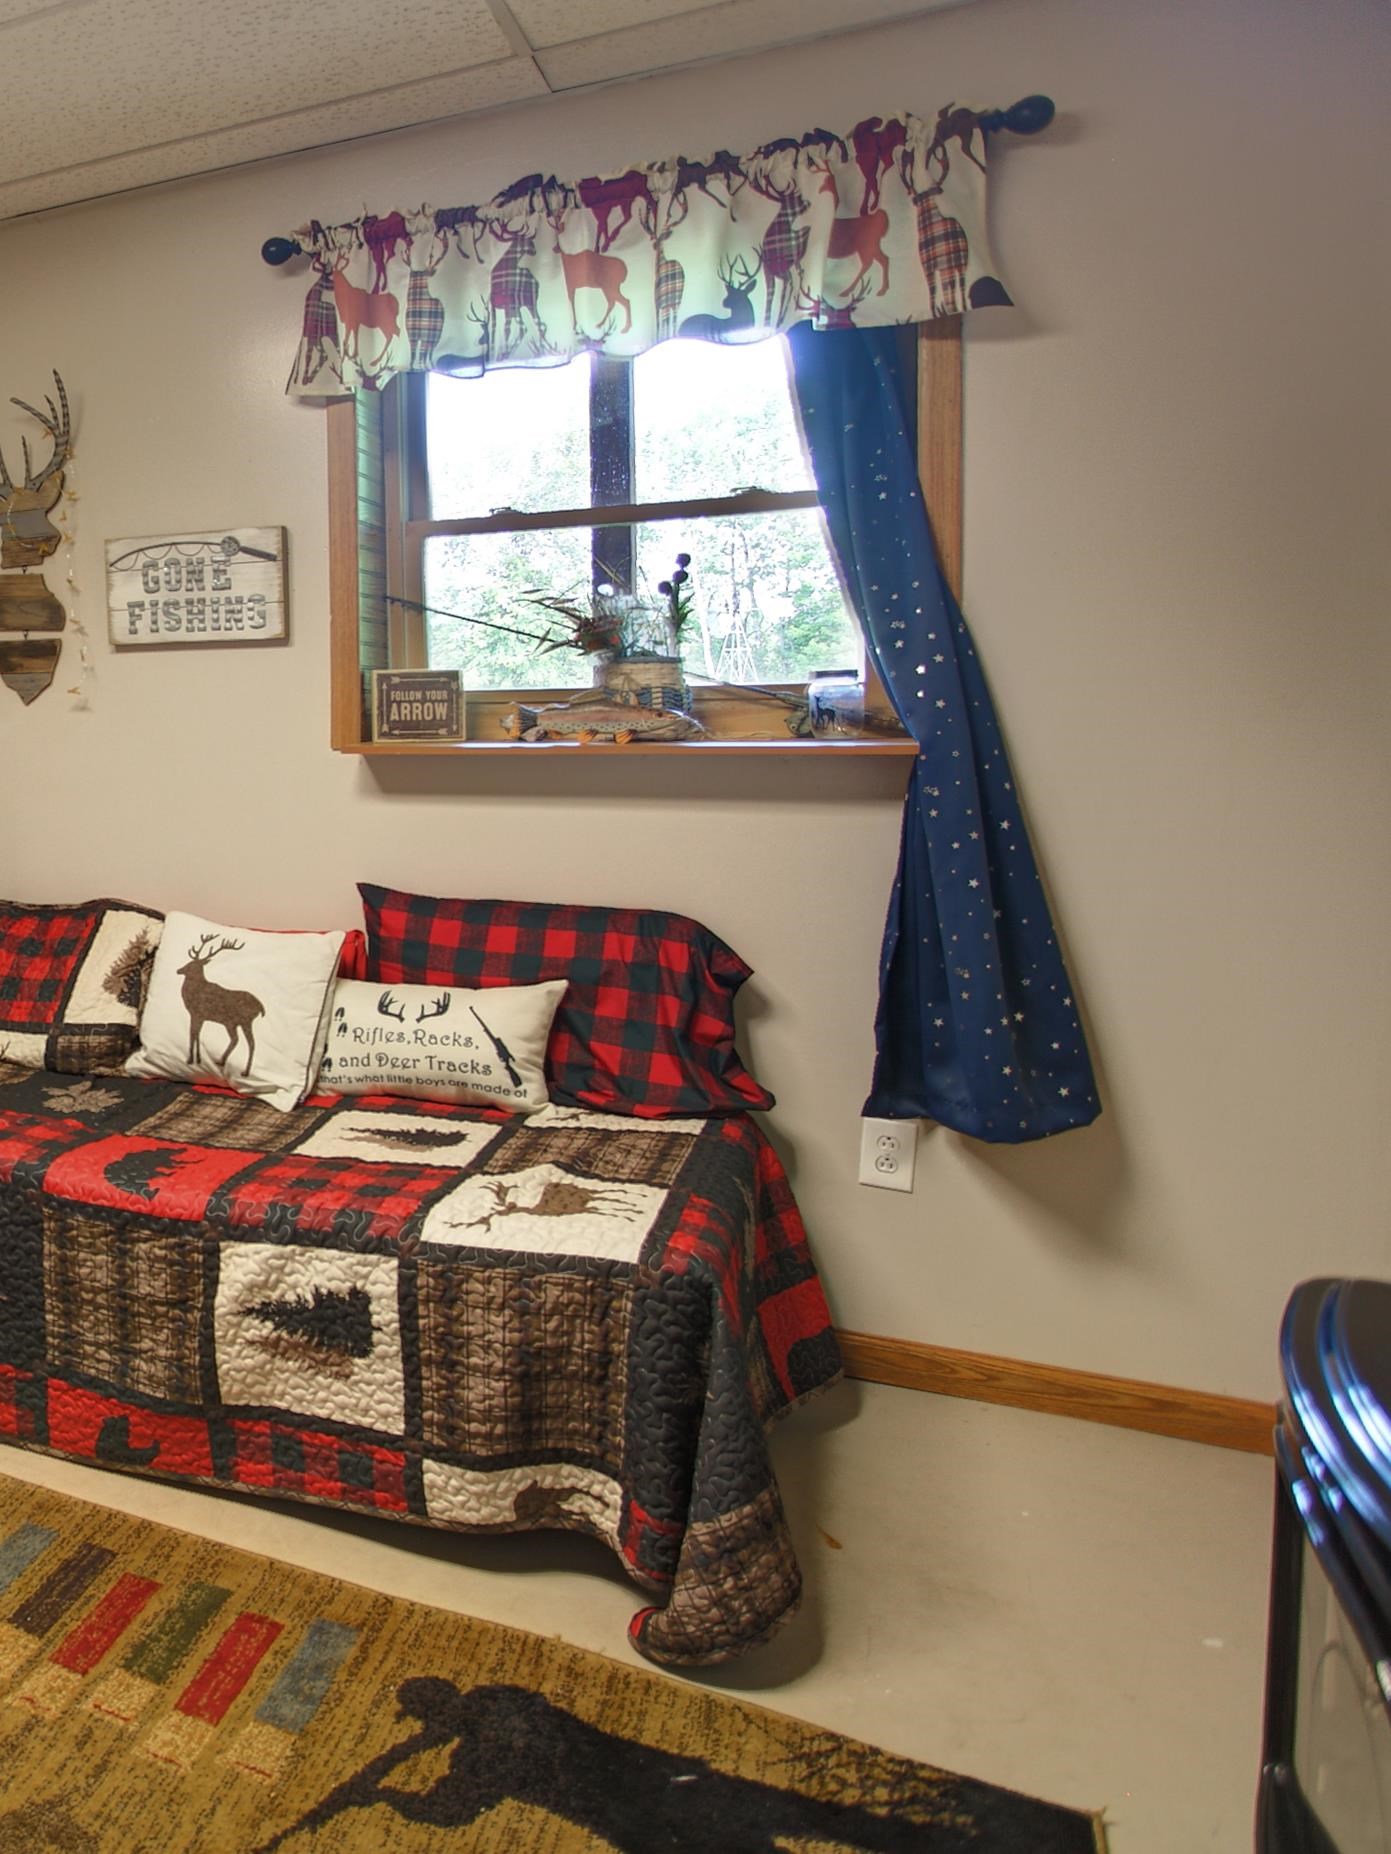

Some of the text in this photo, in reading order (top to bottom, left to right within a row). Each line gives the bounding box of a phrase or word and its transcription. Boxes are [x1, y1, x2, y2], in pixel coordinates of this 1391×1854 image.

[142, 555, 232, 594] GONE
[127, 593, 267, 634] FISHING
[391, 690, 448, 701] FOLLOW YOUR
[389, 702, 448, 721] ARROW
[352, 1027, 480, 1050] Rifles, Racks,
[338, 1052, 493, 1077] and Deer Tracks
[355, 1074, 384, 1083] what
[386, 1075, 413, 1084] little
[416, 1076, 446, 1088] boys
[471, 1081, 511, 1096] made
[514, 1089, 528, 1099] of
